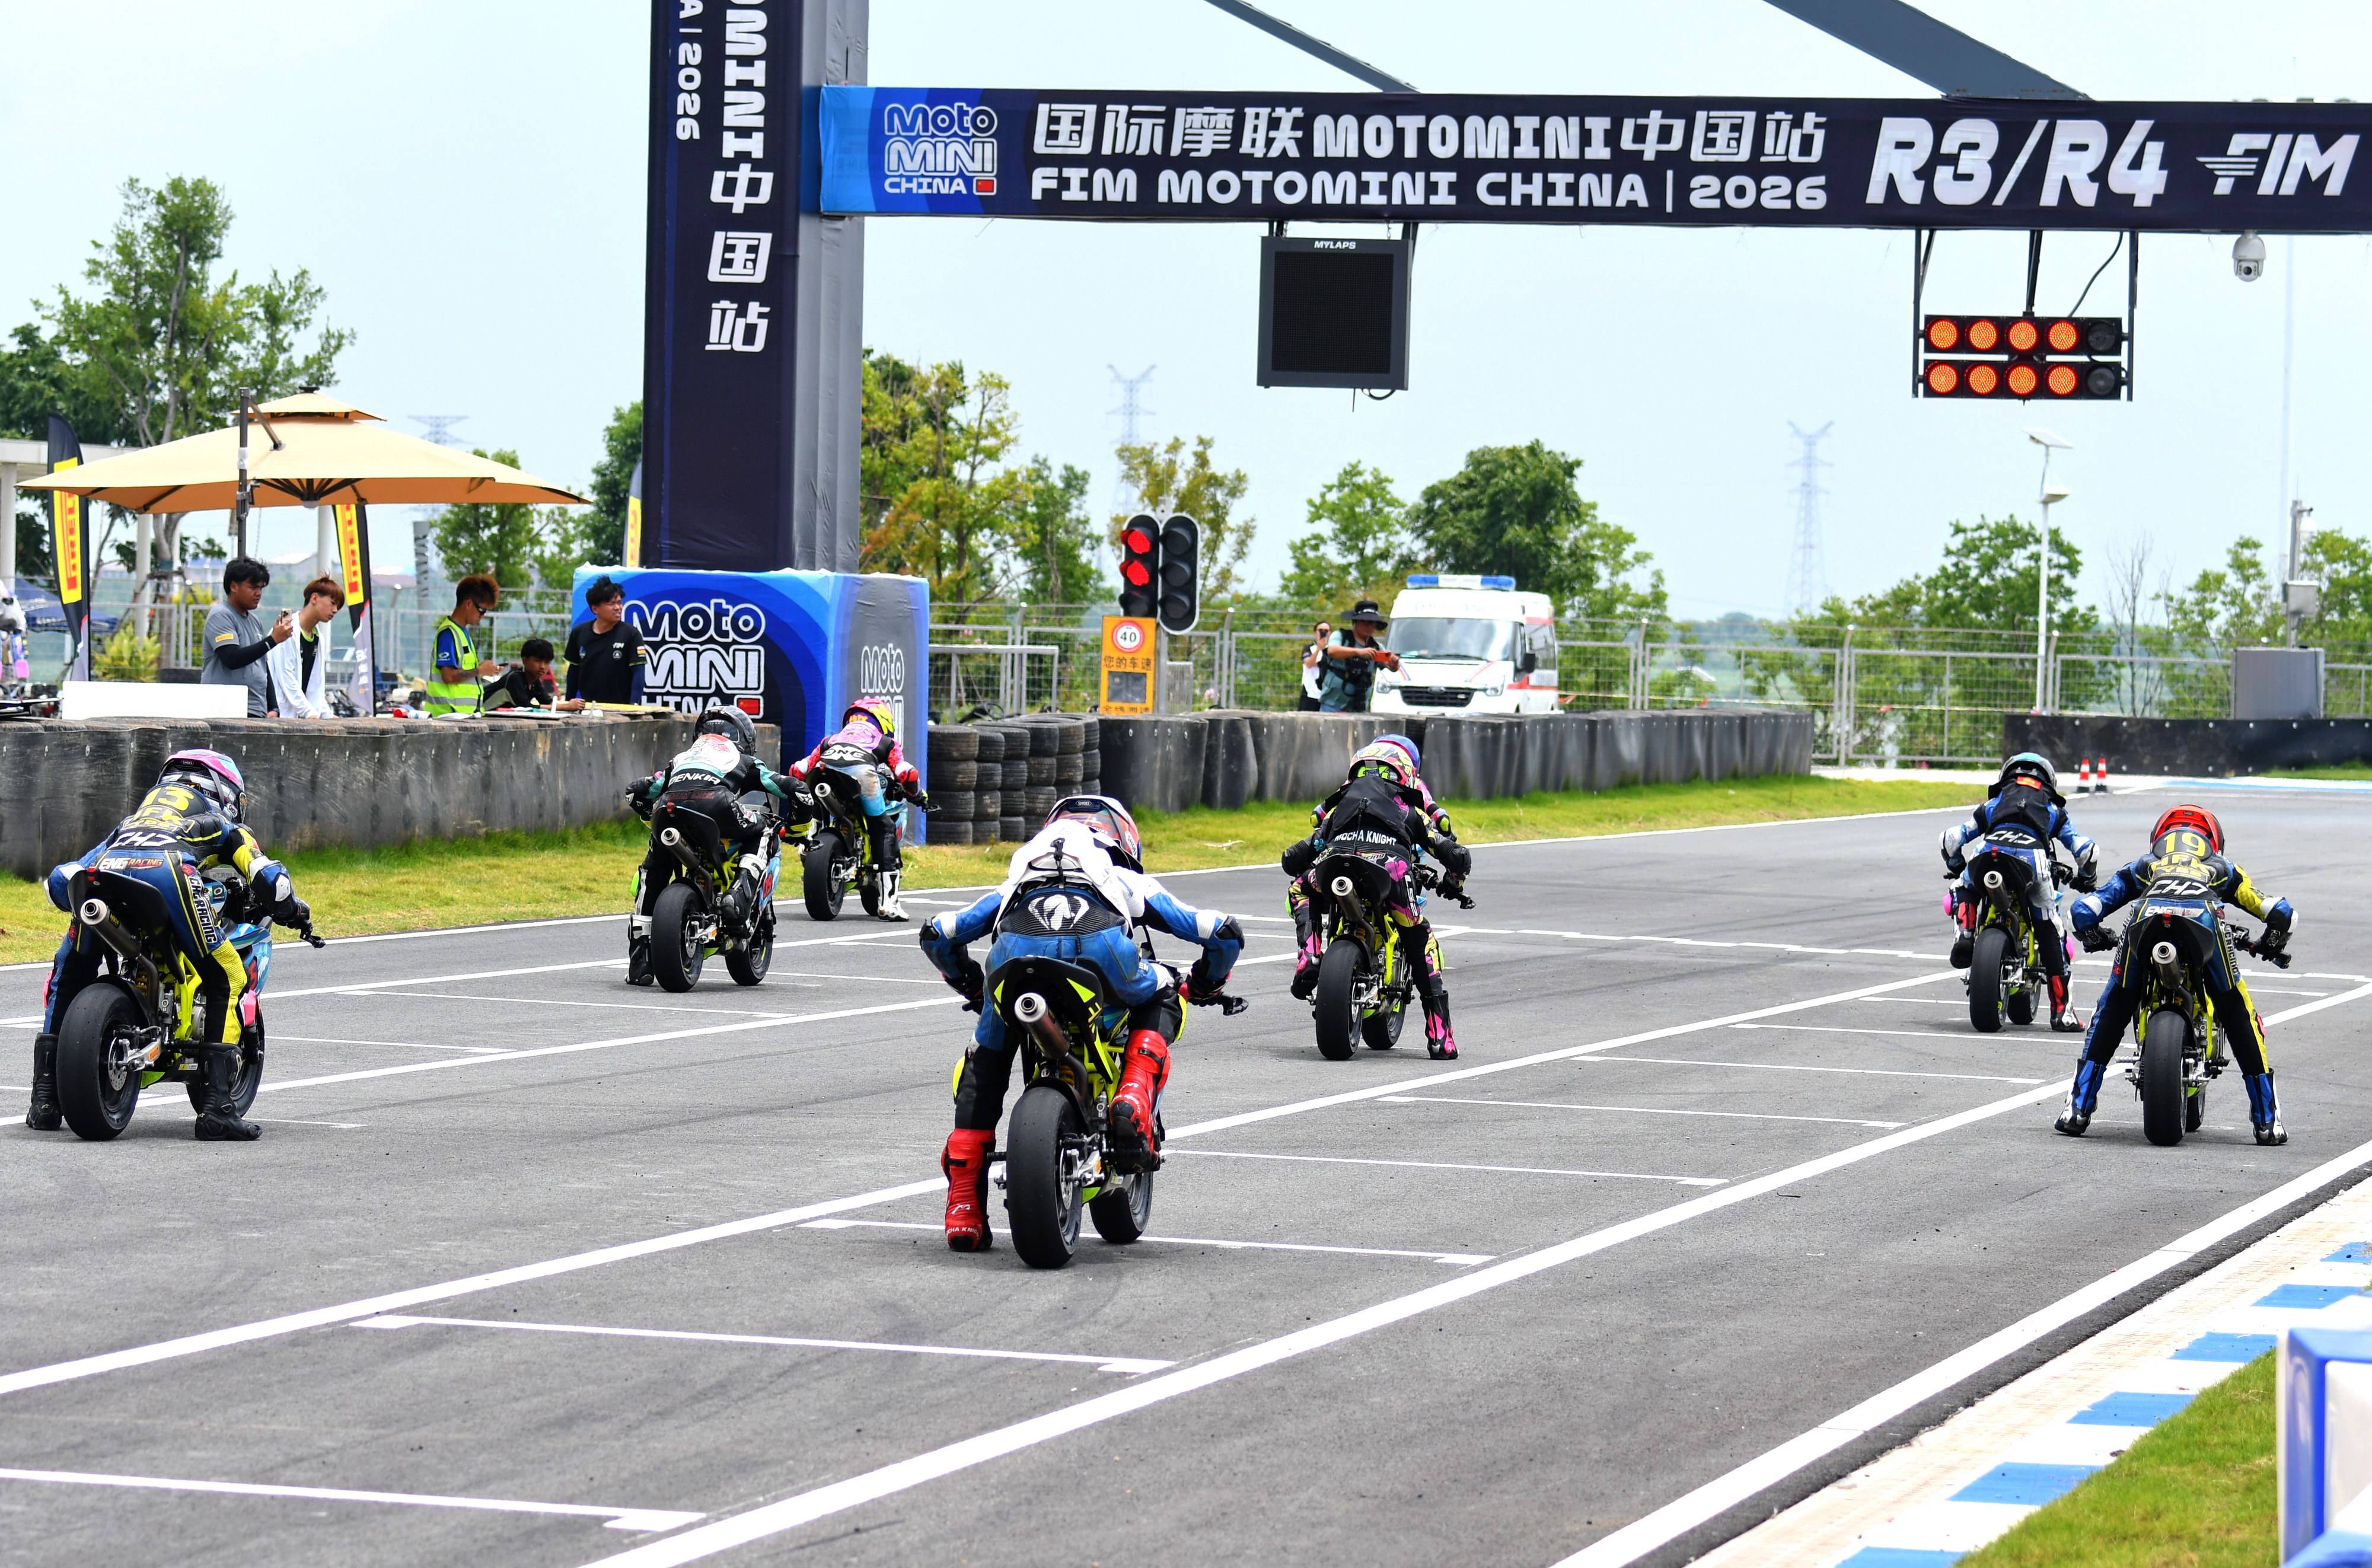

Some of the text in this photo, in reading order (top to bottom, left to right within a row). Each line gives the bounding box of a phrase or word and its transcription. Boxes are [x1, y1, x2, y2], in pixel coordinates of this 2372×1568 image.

[676, 42, 702, 141] 2026
[884, 103, 998, 138] Moto
[884, 137, 998, 176] MINI
[1865, 117, 2169, 208] R3/R4
[2195, 133, 2361, 196] FIM
[884, 177, 968, 195] CHINA
[1031, 167, 1137, 203] FIM
[1158, 170, 1458, 205] MOTOMINI
[1476, 172, 1649, 208] CHINA
[1689, 175, 1828, 210] 2026
[1314, 240, 1357, 250] MYLAPS
[622, 599, 766, 643] Moto
[1120, 631, 1137, 643] 40
[861, 643, 904, 694] Moto
[1104, 655, 1152, 671] 您的车速
[141, 785, 194, 811] 13
[1334, 830, 1397, 846] MOCHA KNIGHT
[2163, 832, 2205, 858] 19
